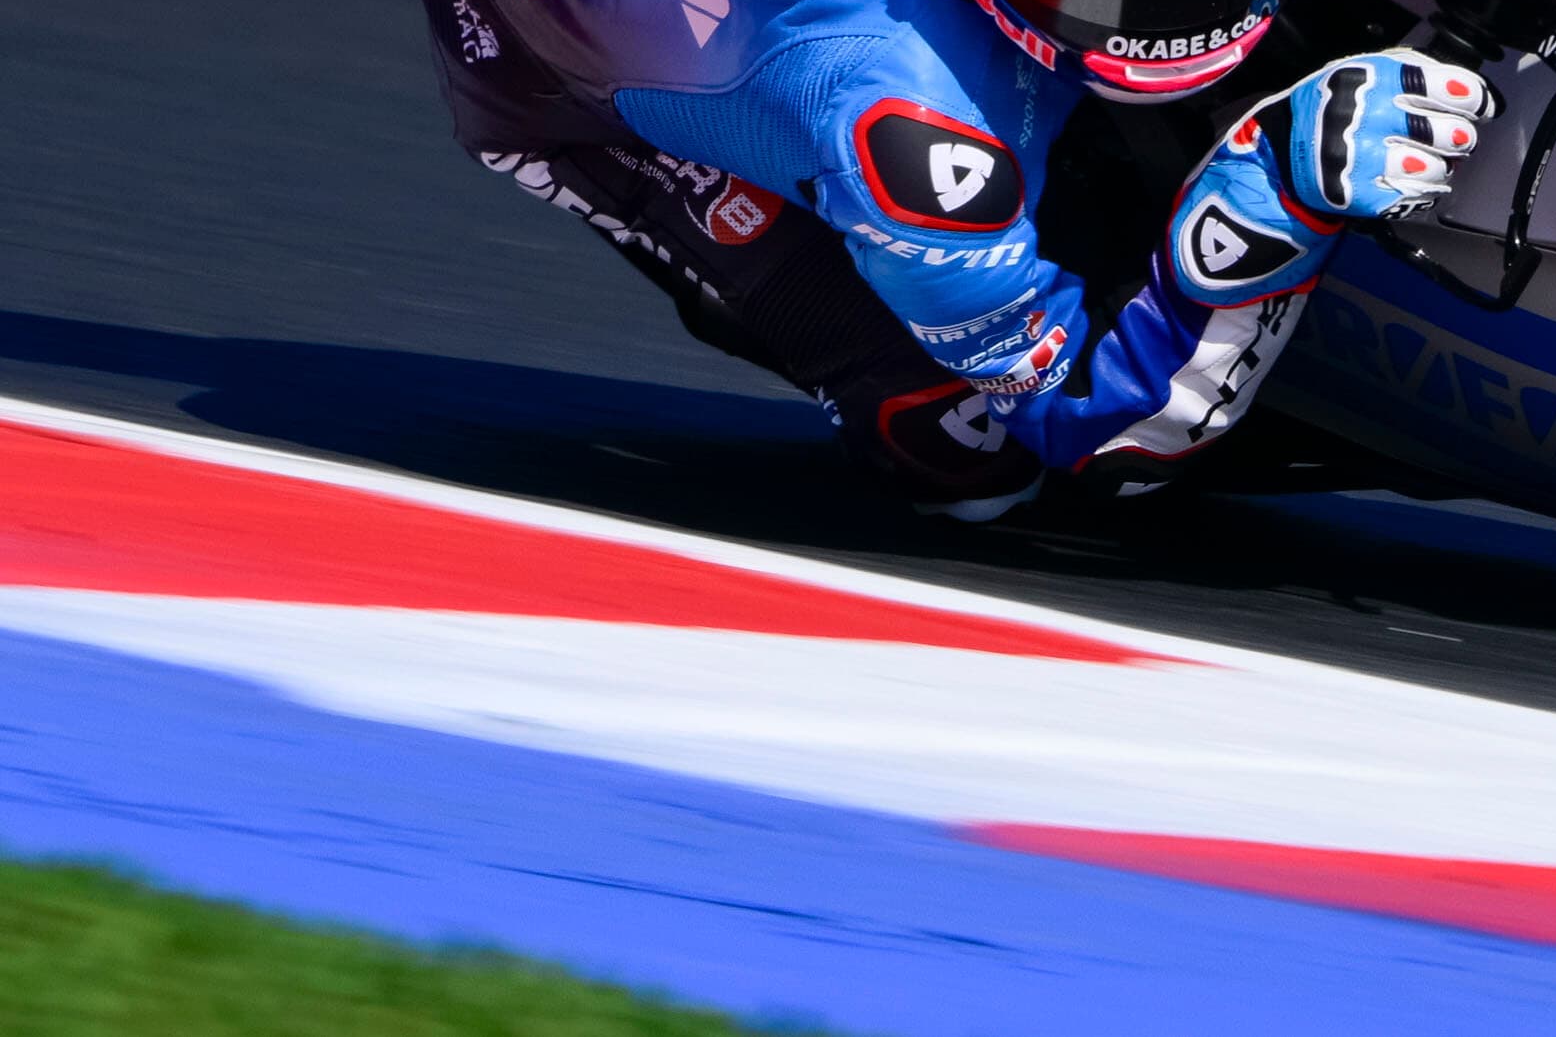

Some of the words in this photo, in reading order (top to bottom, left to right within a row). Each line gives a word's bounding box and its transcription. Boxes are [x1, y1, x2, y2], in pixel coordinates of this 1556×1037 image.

[1106, 32, 1205, 60] OKABE
[1208, 28, 1229, 50] &
[853, 223, 1027, 269] REV'IT!
